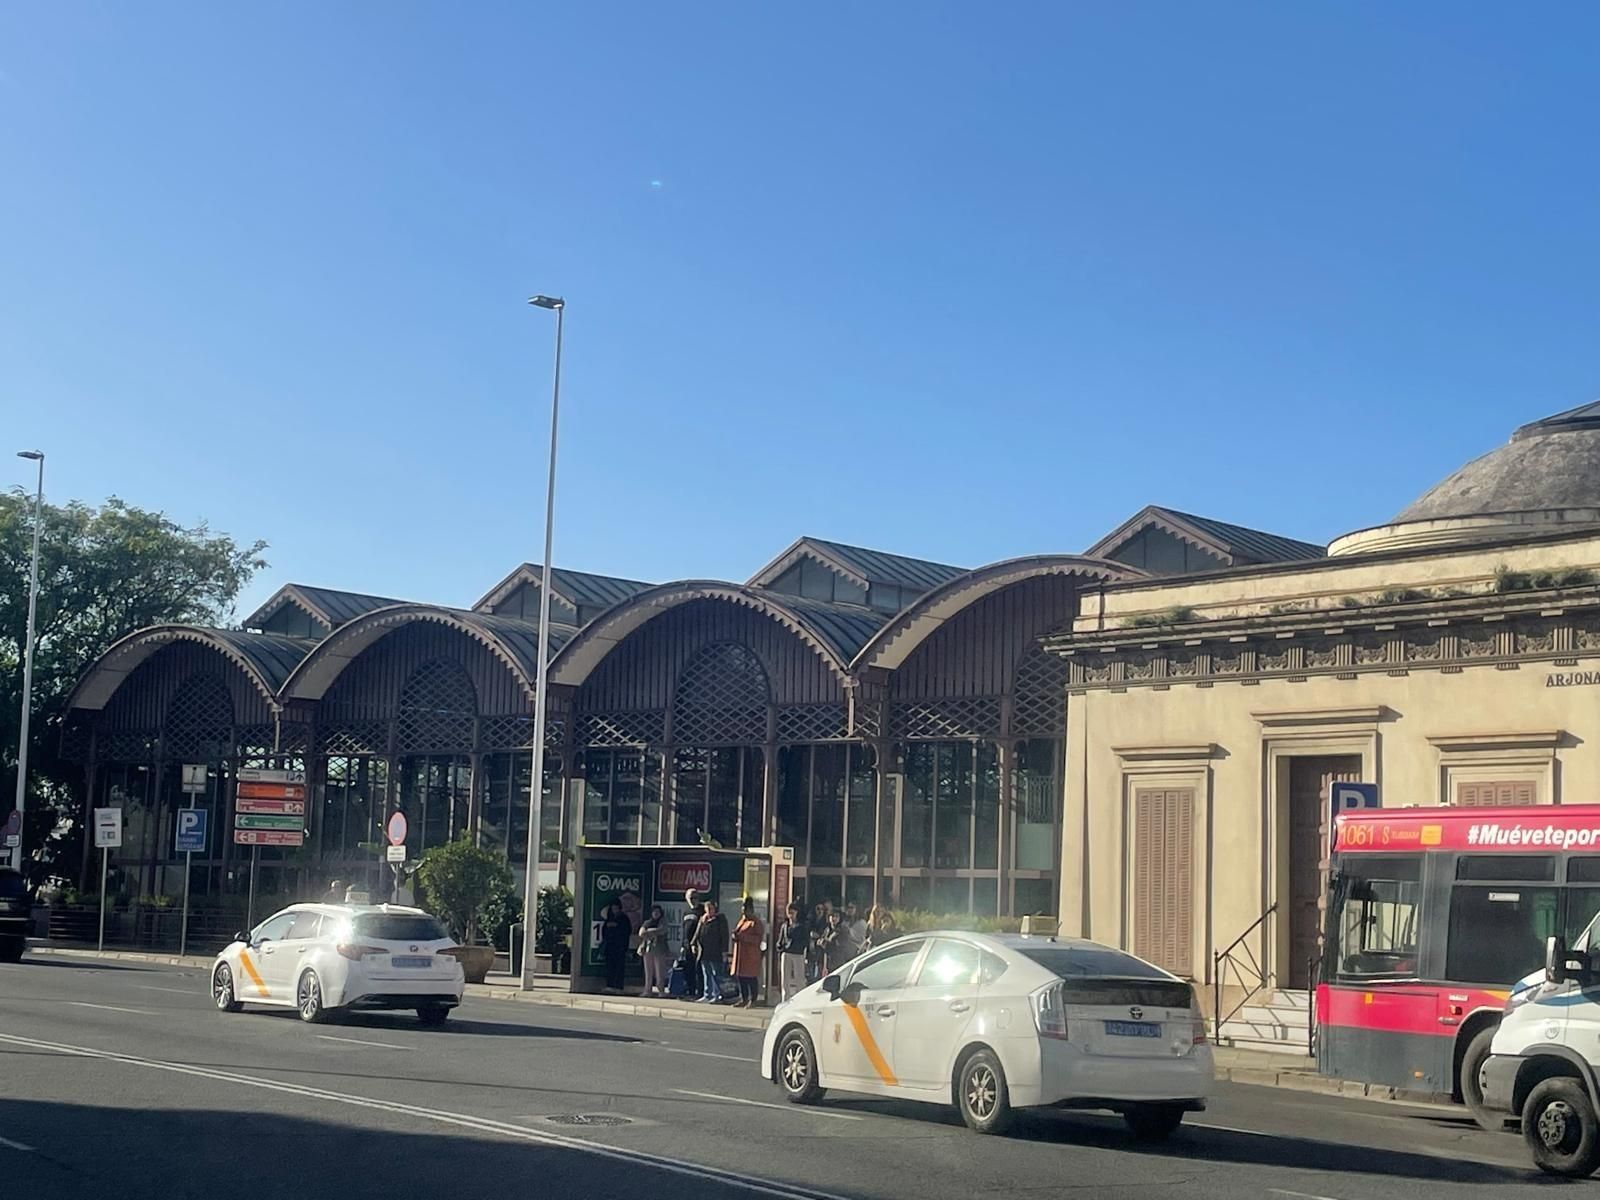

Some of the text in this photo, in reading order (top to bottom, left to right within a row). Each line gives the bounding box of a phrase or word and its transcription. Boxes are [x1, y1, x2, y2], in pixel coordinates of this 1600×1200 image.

[1546, 672, 1600, 687] ARJONA
[181, 812, 199, 834] P
[1338, 825, 1374, 846] 1061
[1468, 825, 1600, 849] #Muévetepor
[611, 878, 640, 890] MAS
